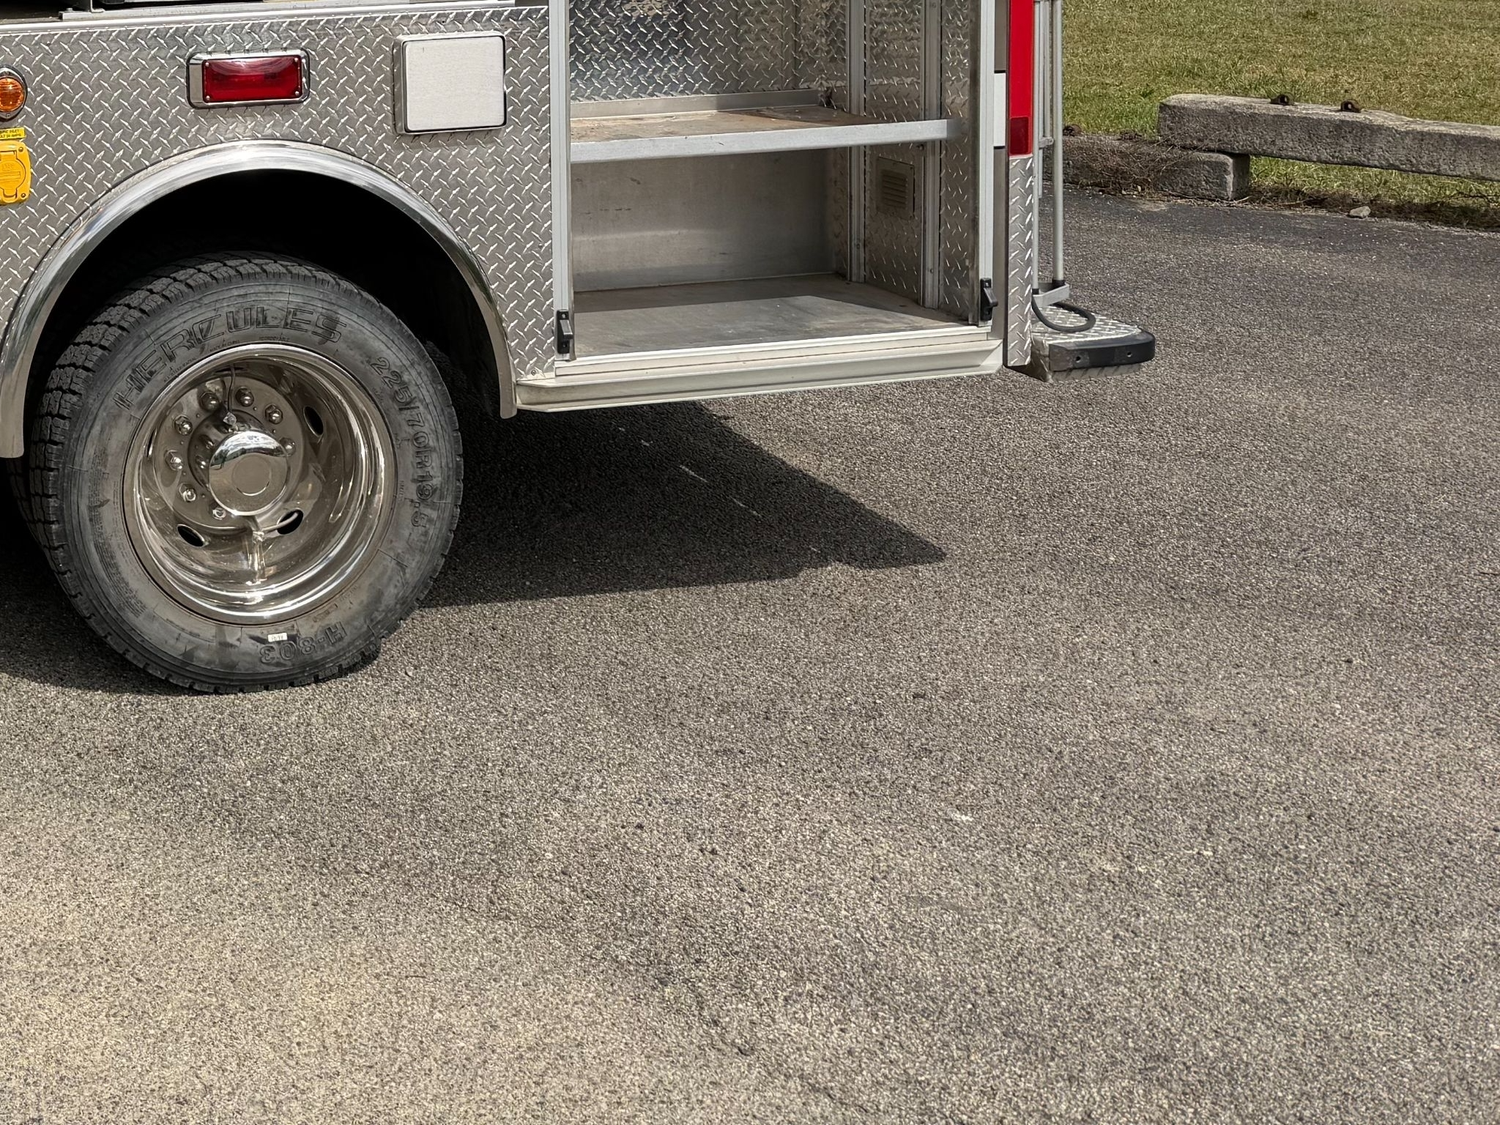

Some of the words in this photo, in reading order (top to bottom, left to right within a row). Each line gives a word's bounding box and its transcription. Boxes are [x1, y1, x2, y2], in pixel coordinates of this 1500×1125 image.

[112, 306, 348, 411] HERCULES
[370, 356, 434, 528] 225/70R19.5
[260, 621, 347, 664] H-803
